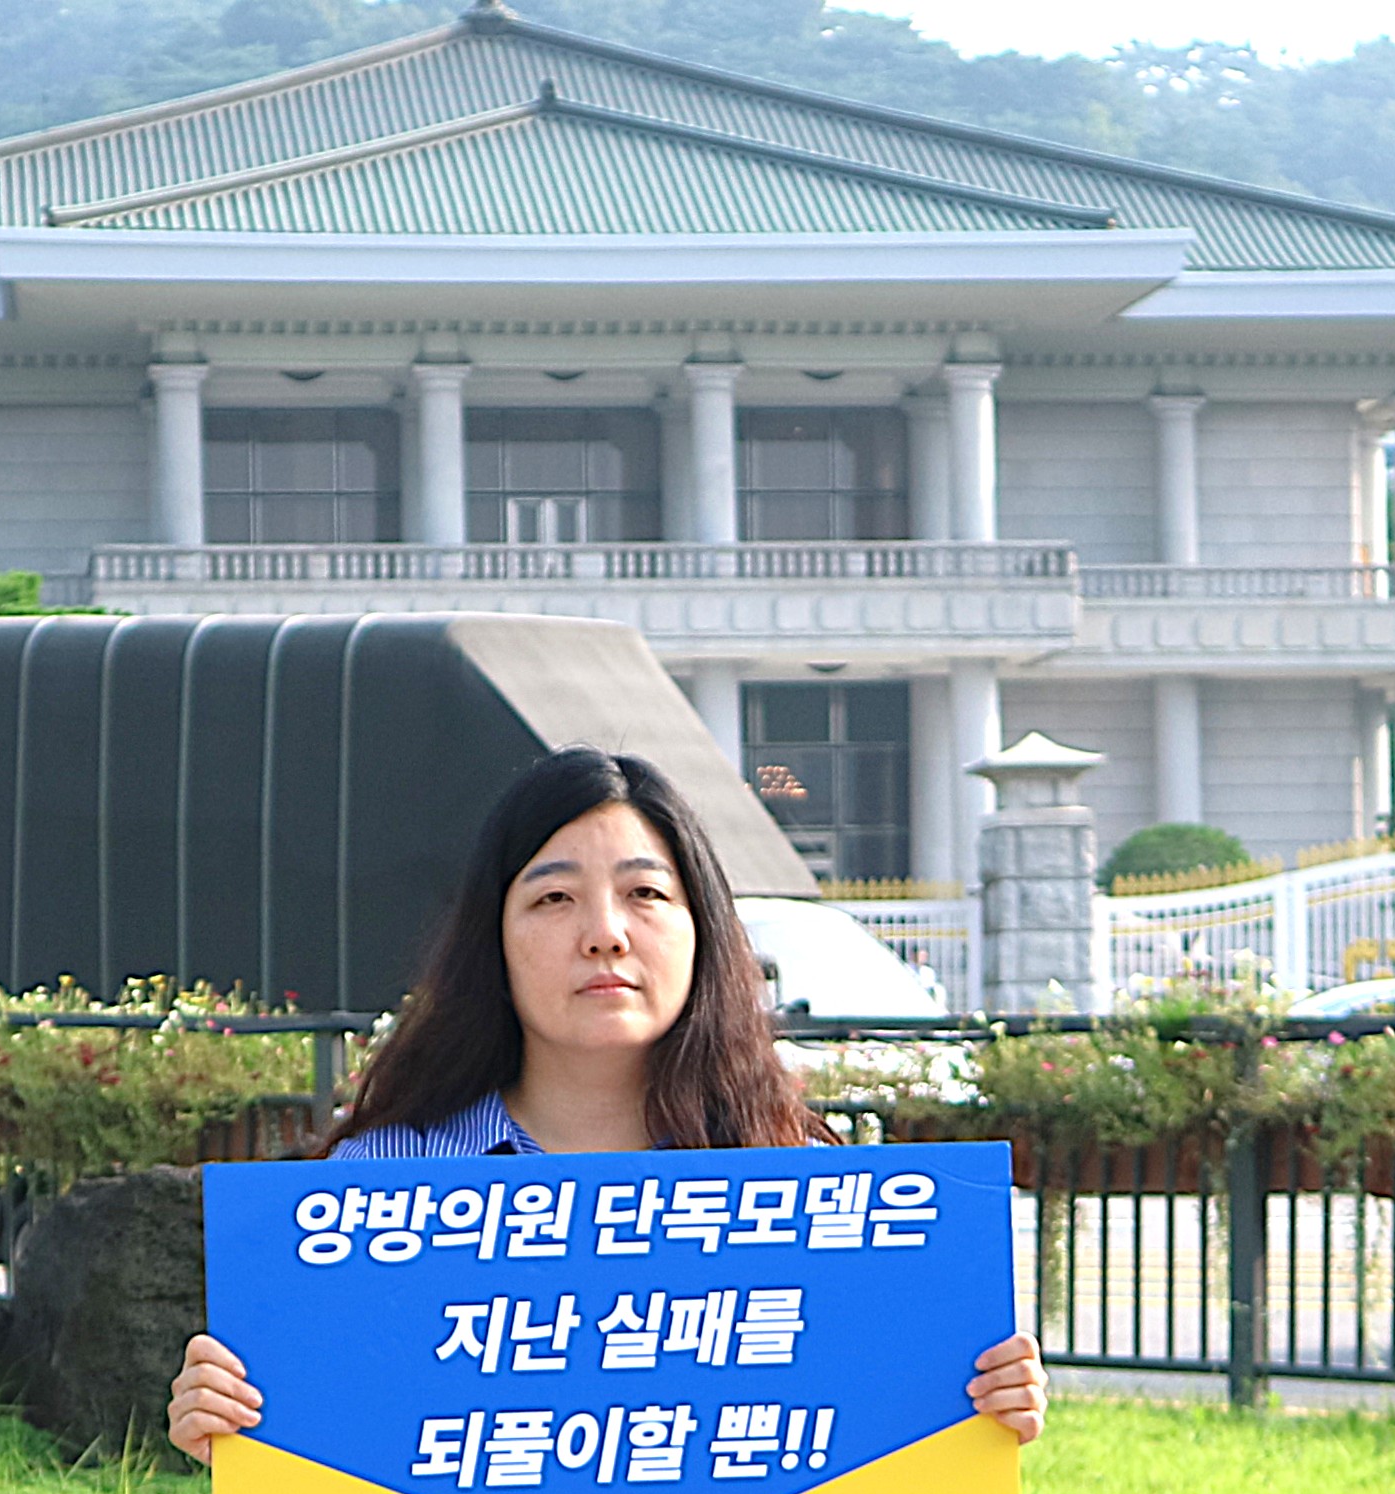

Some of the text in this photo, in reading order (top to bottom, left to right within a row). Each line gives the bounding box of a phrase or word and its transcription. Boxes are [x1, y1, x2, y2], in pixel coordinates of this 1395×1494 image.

[296, 1173, 937, 1264] 양방의원 단독모델은
[435, 1288, 804, 1373] 지난 실패를
[411, 1404, 835, 1488] 되풀이할 뿐!!
